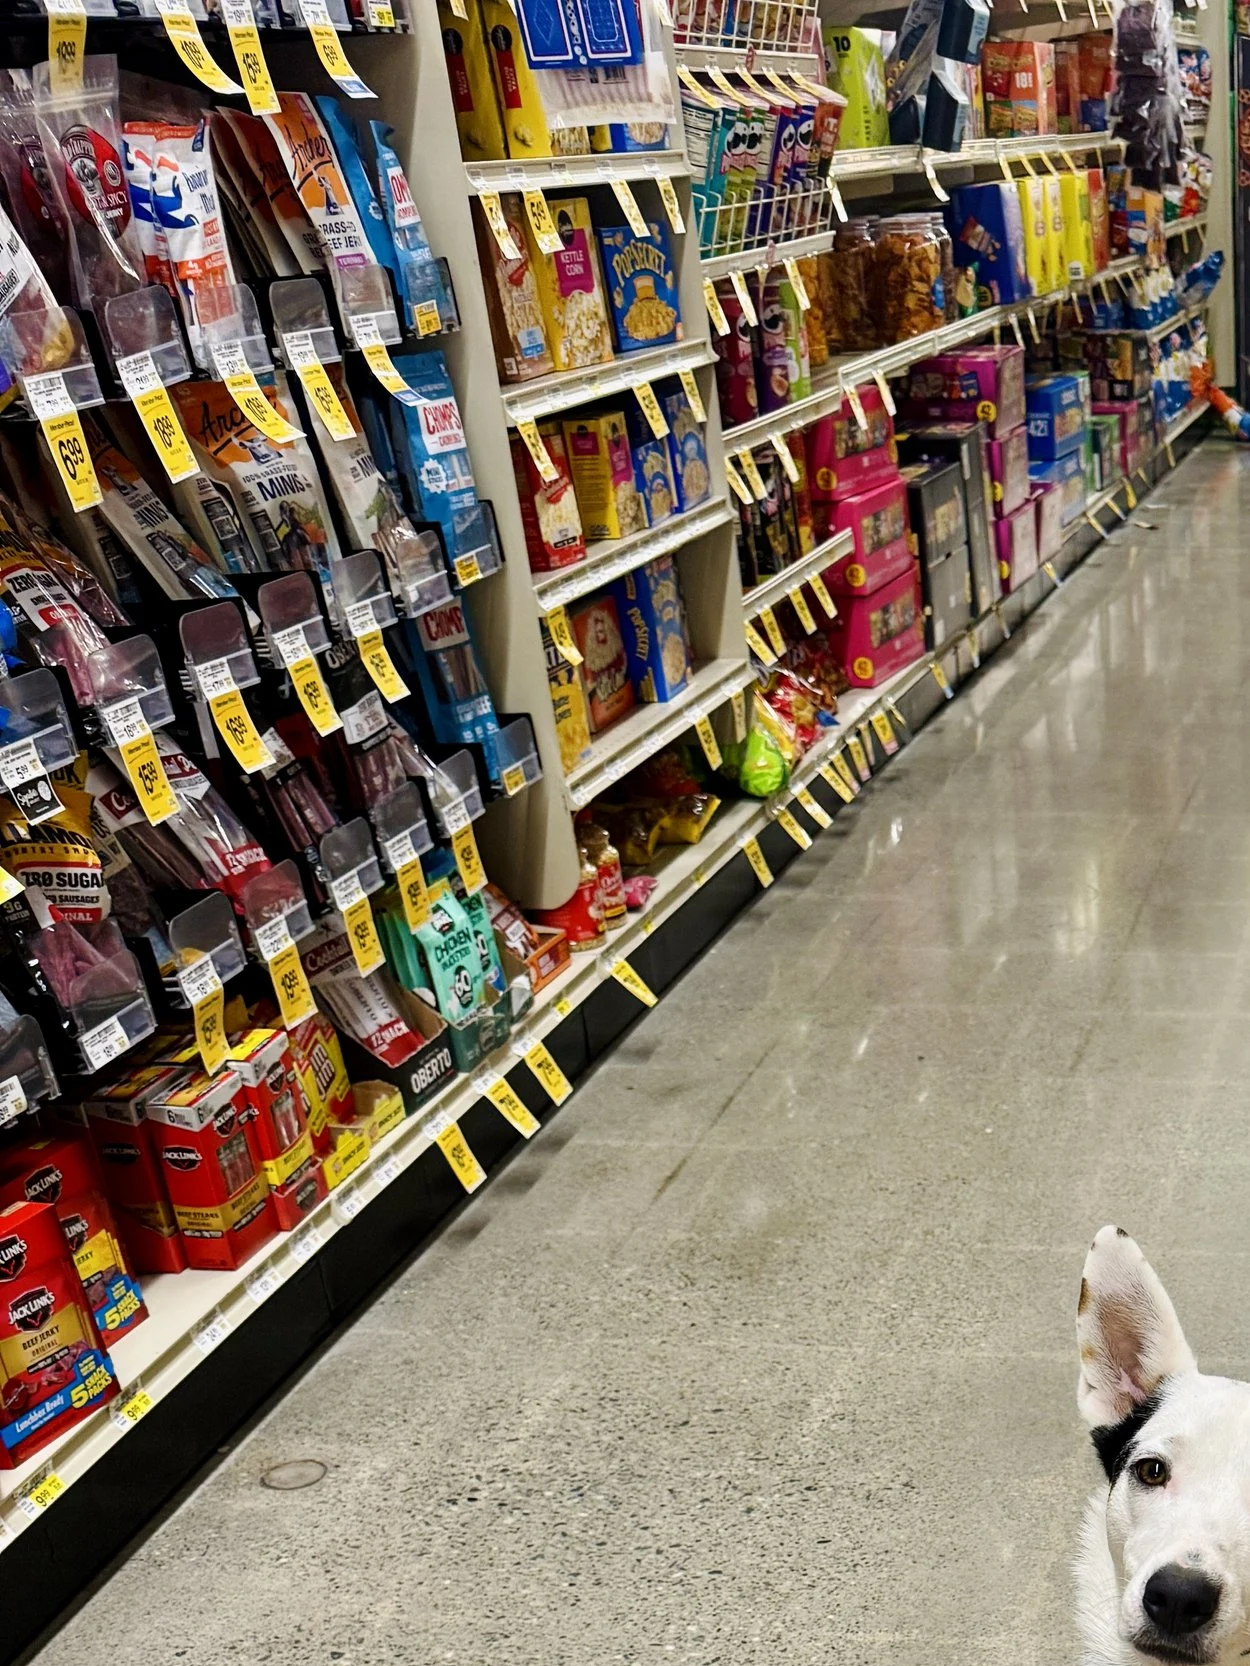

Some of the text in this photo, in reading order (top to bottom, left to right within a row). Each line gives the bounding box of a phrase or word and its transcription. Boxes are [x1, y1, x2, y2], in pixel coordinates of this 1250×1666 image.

[832, 36, 851, 53] 10
[559, 249, 585, 264] KETTLE
[565, 263, 585, 277] CORN
[422, 402, 463, 436] CHOMPS
[58, 437, 85, 479] 699
[423, 609, 465, 642] CHOMP
[138, 760, 160, 796] 1599
[4, 900, 23, 914] 9G
[58, 893, 101, 904] SAUSAGES
[454, 966, 472, 997] 60
[411, 1048, 452, 1094] OBERTO
[167, 1108, 176, 1125] 6
[25, 1168, 64, 1198] JACK LINK'S
[2, 1238, 28, 1263] LINK'S
[9, 1290, 56, 1326] JACK LINK'S
[105, 1307, 121, 1331] 5
[22, 1324, 61, 1352] BEEF JERKY
[31, 1339, 59, 1358] ORIGINAL
[85, 1364, 111, 1391] SNACK
[88, 1375, 113, 1400] PACKS
[70, 1386, 91, 1409] 5
[15, 1400, 46, 1434] Lunchbox
[127, 1404, 143, 1422] 999
[35, 1489, 52, 1508] 999
